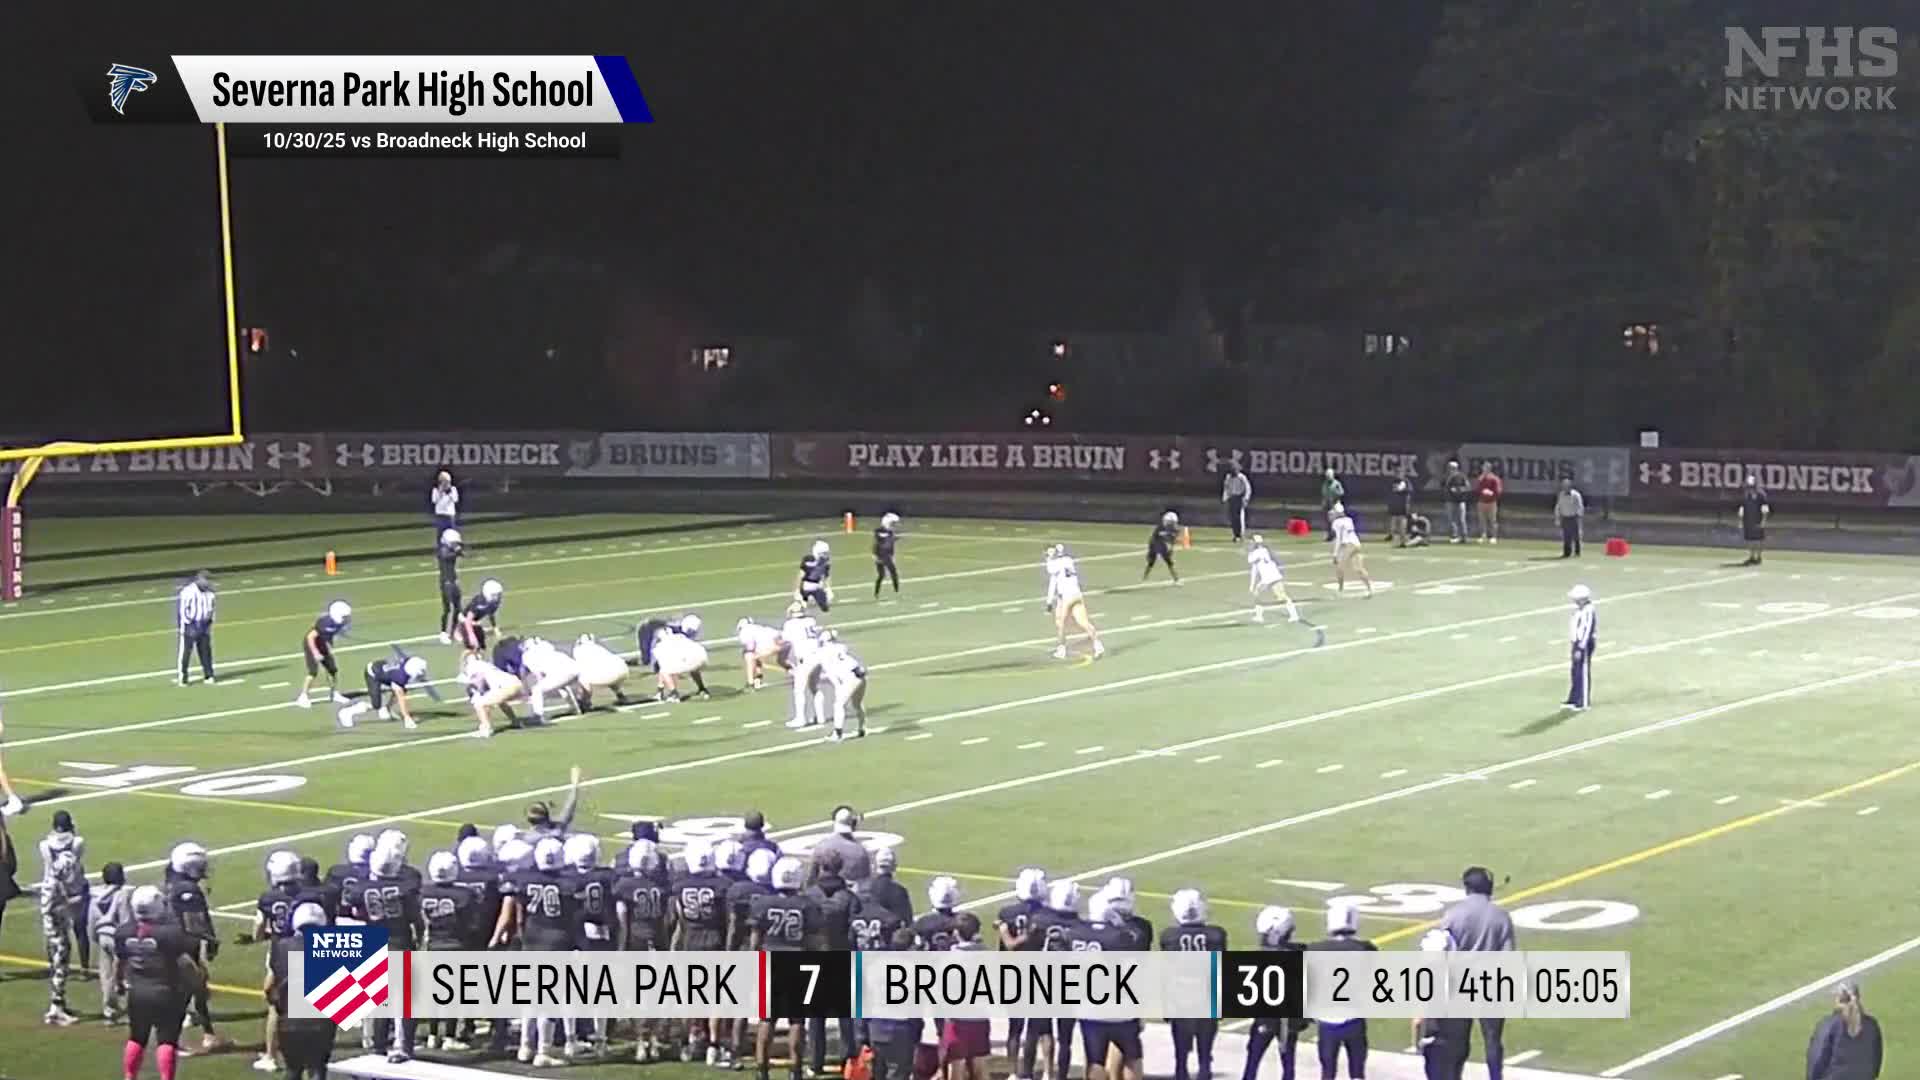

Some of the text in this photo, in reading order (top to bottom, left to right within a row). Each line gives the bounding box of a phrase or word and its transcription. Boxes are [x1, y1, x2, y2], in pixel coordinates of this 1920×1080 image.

[382, 443, 560, 466] BROADNECK
[609, 444, 717, 466] BRUINS
[848, 444, 1126, 470] PLAY LIKE A BRUIN
[1249, 450, 1418, 478] BROADNECK
[1679, 460, 1873, 493] BROADNECK
[12, 511, 23, 598] BRUINS
[767, 908, 802, 941] 72
